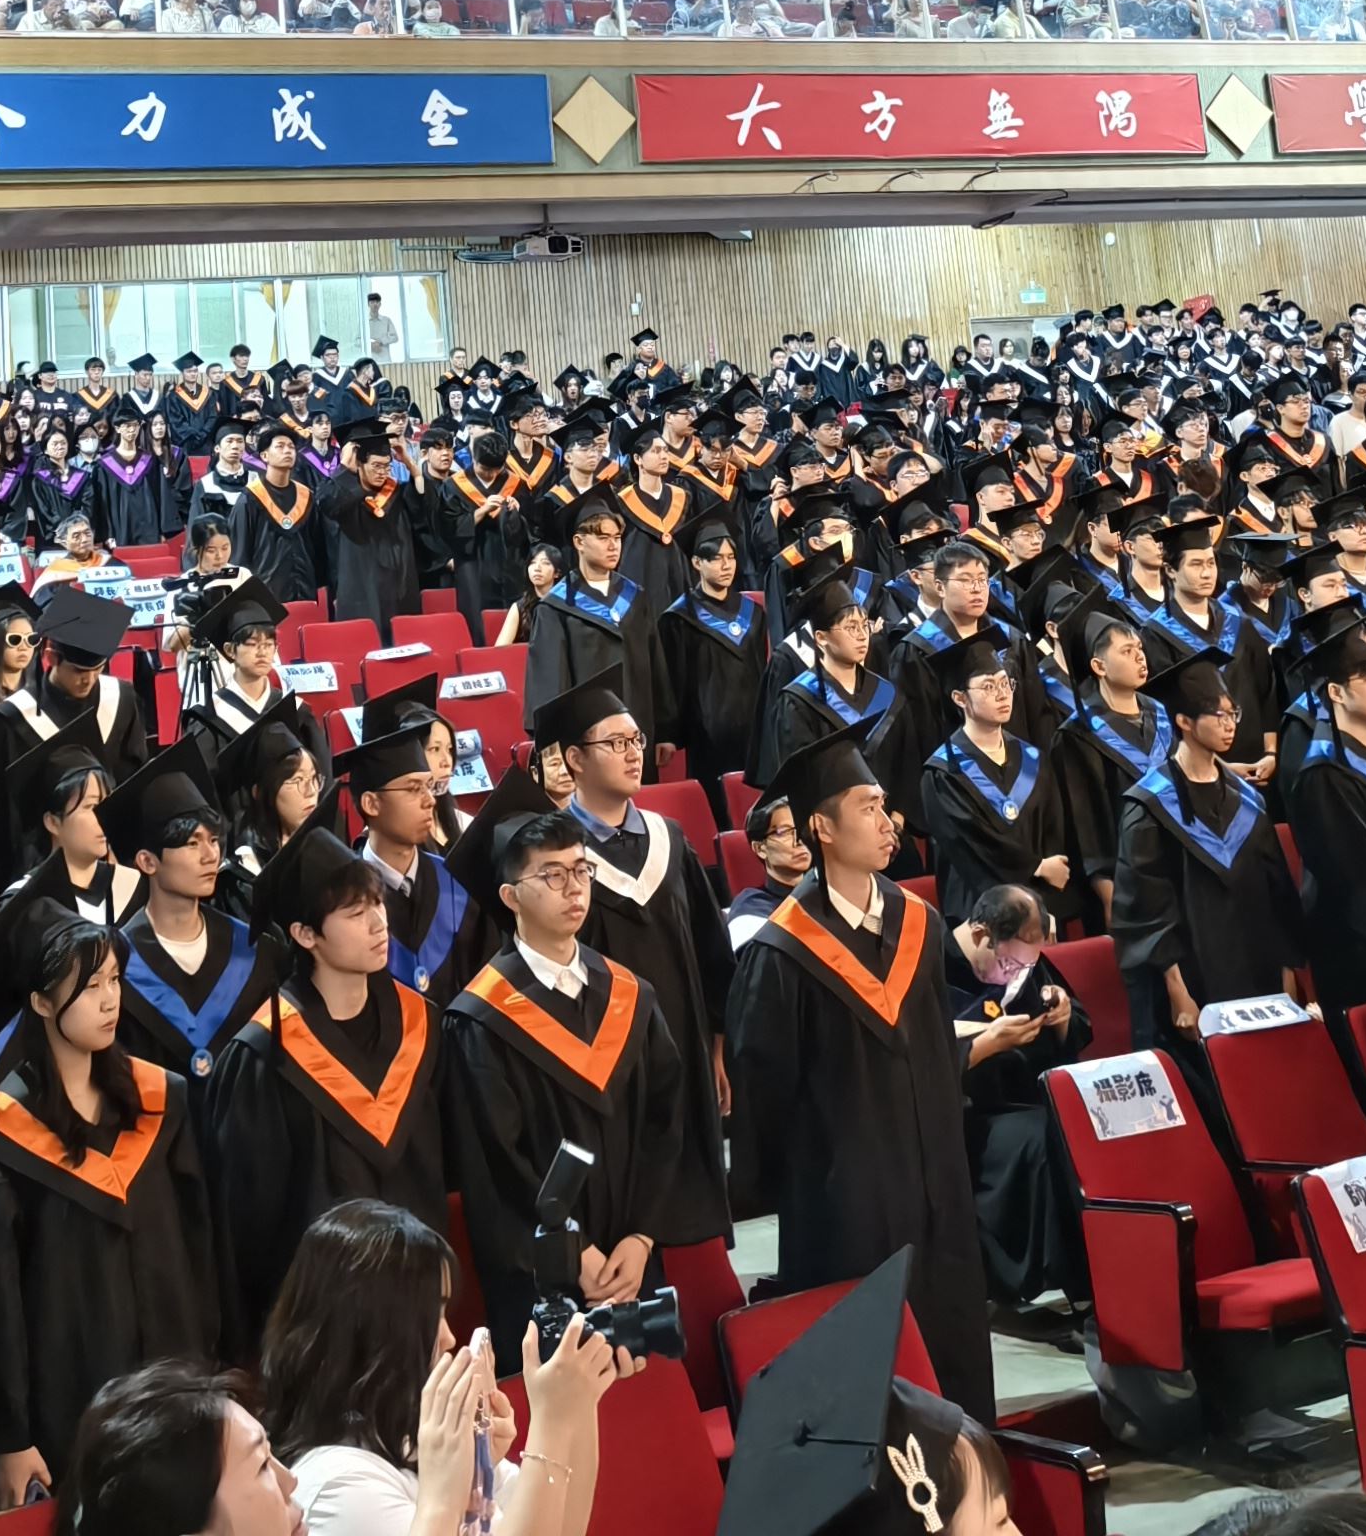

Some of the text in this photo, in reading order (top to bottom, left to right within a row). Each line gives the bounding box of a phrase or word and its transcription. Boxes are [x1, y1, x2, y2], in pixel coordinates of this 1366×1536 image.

[726, 82, 1139, 151] 大方無隅
[1092, 1070, 1157, 1104] 攝影席
